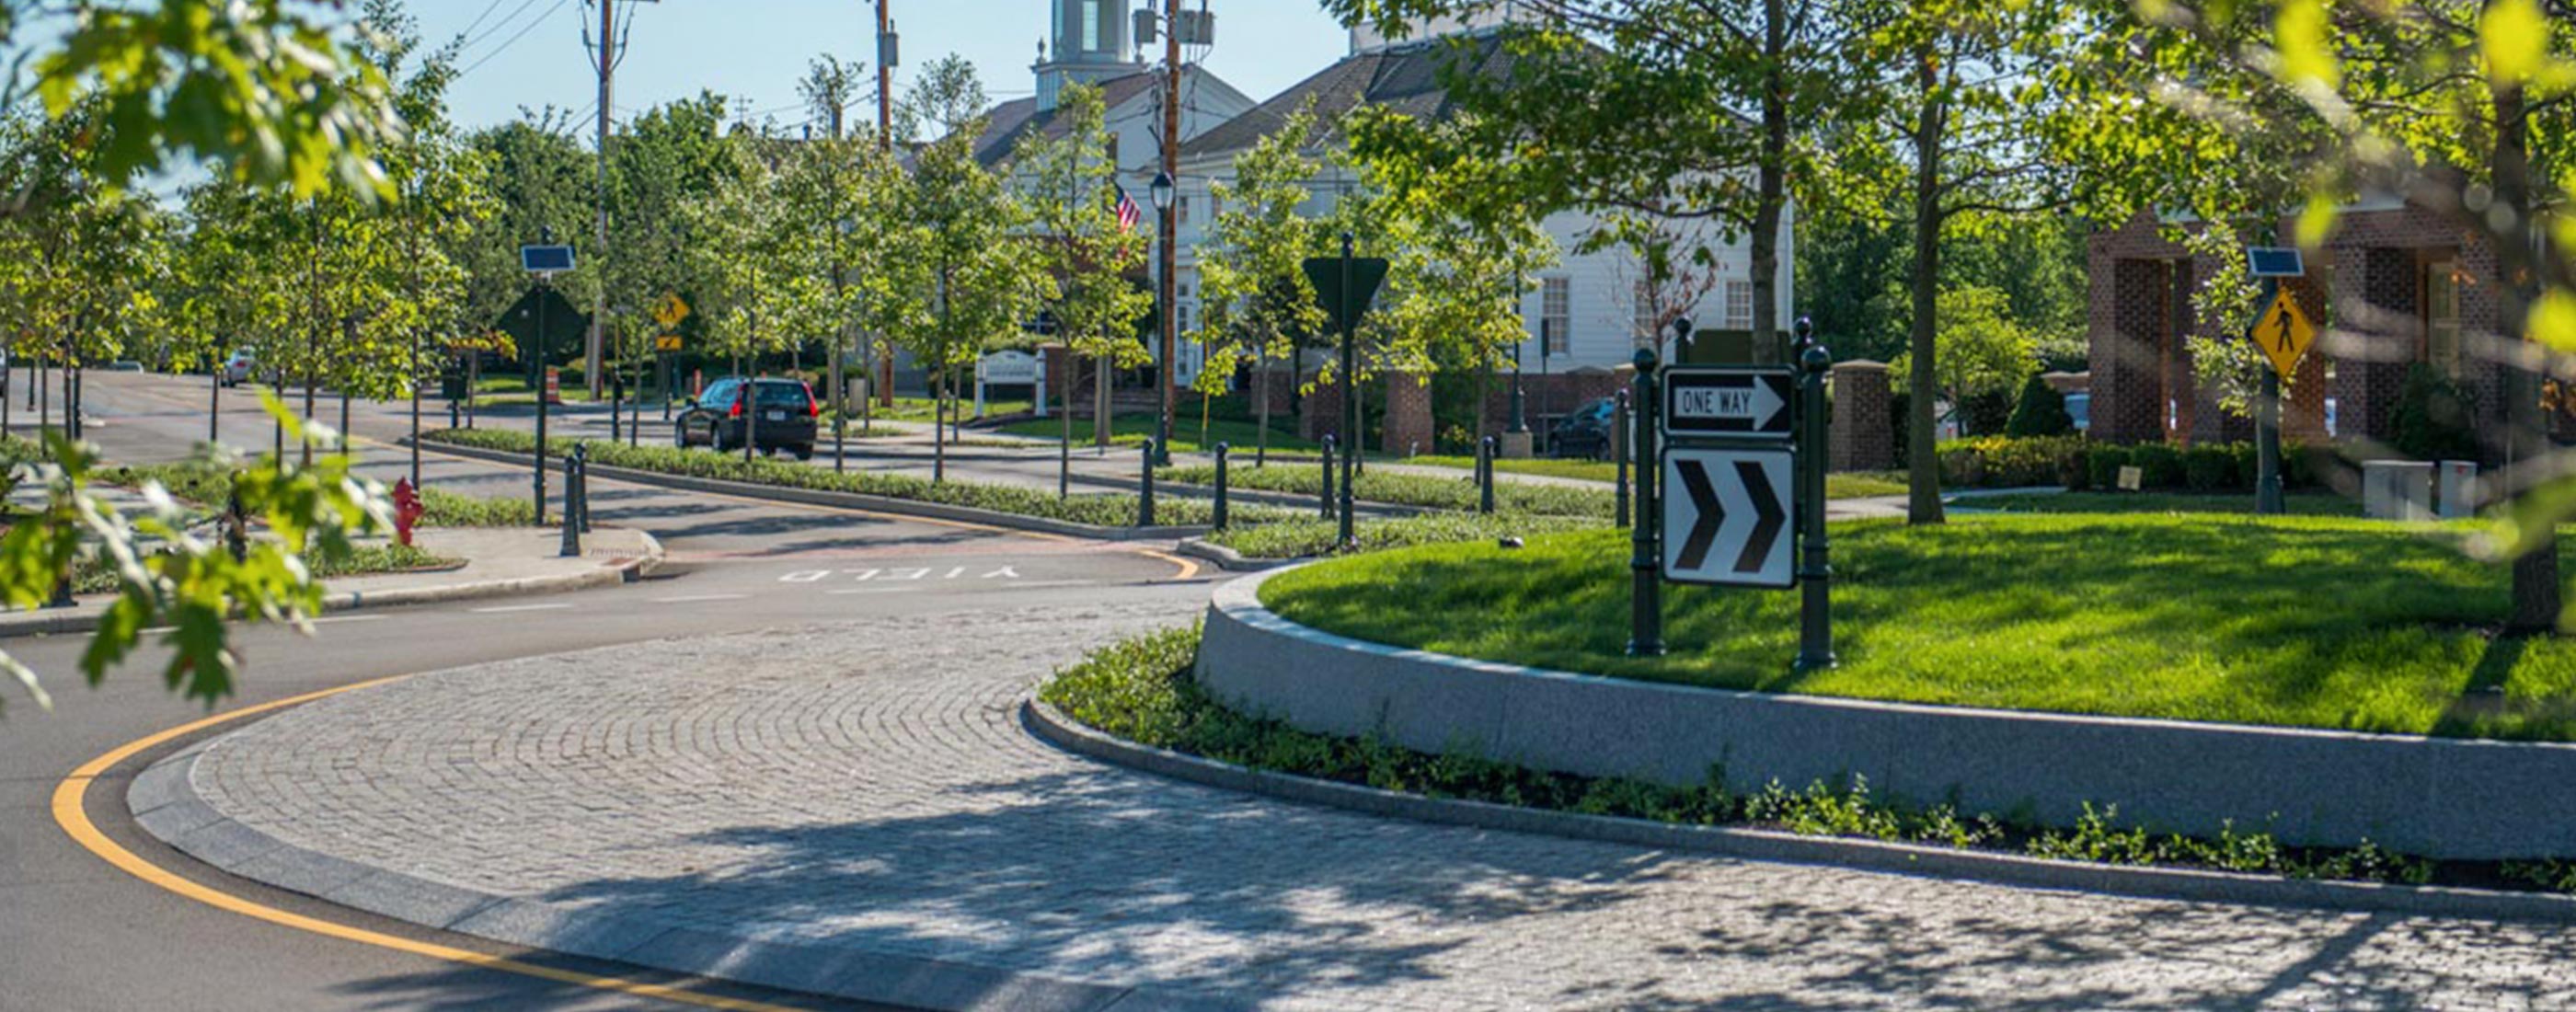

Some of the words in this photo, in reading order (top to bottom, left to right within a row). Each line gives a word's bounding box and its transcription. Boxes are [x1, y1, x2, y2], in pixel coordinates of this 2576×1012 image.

[1683, 390, 1712, 413] ONE
[1719, 391, 1751, 413] WAY
[777, 566, 1019, 581] YIELD
